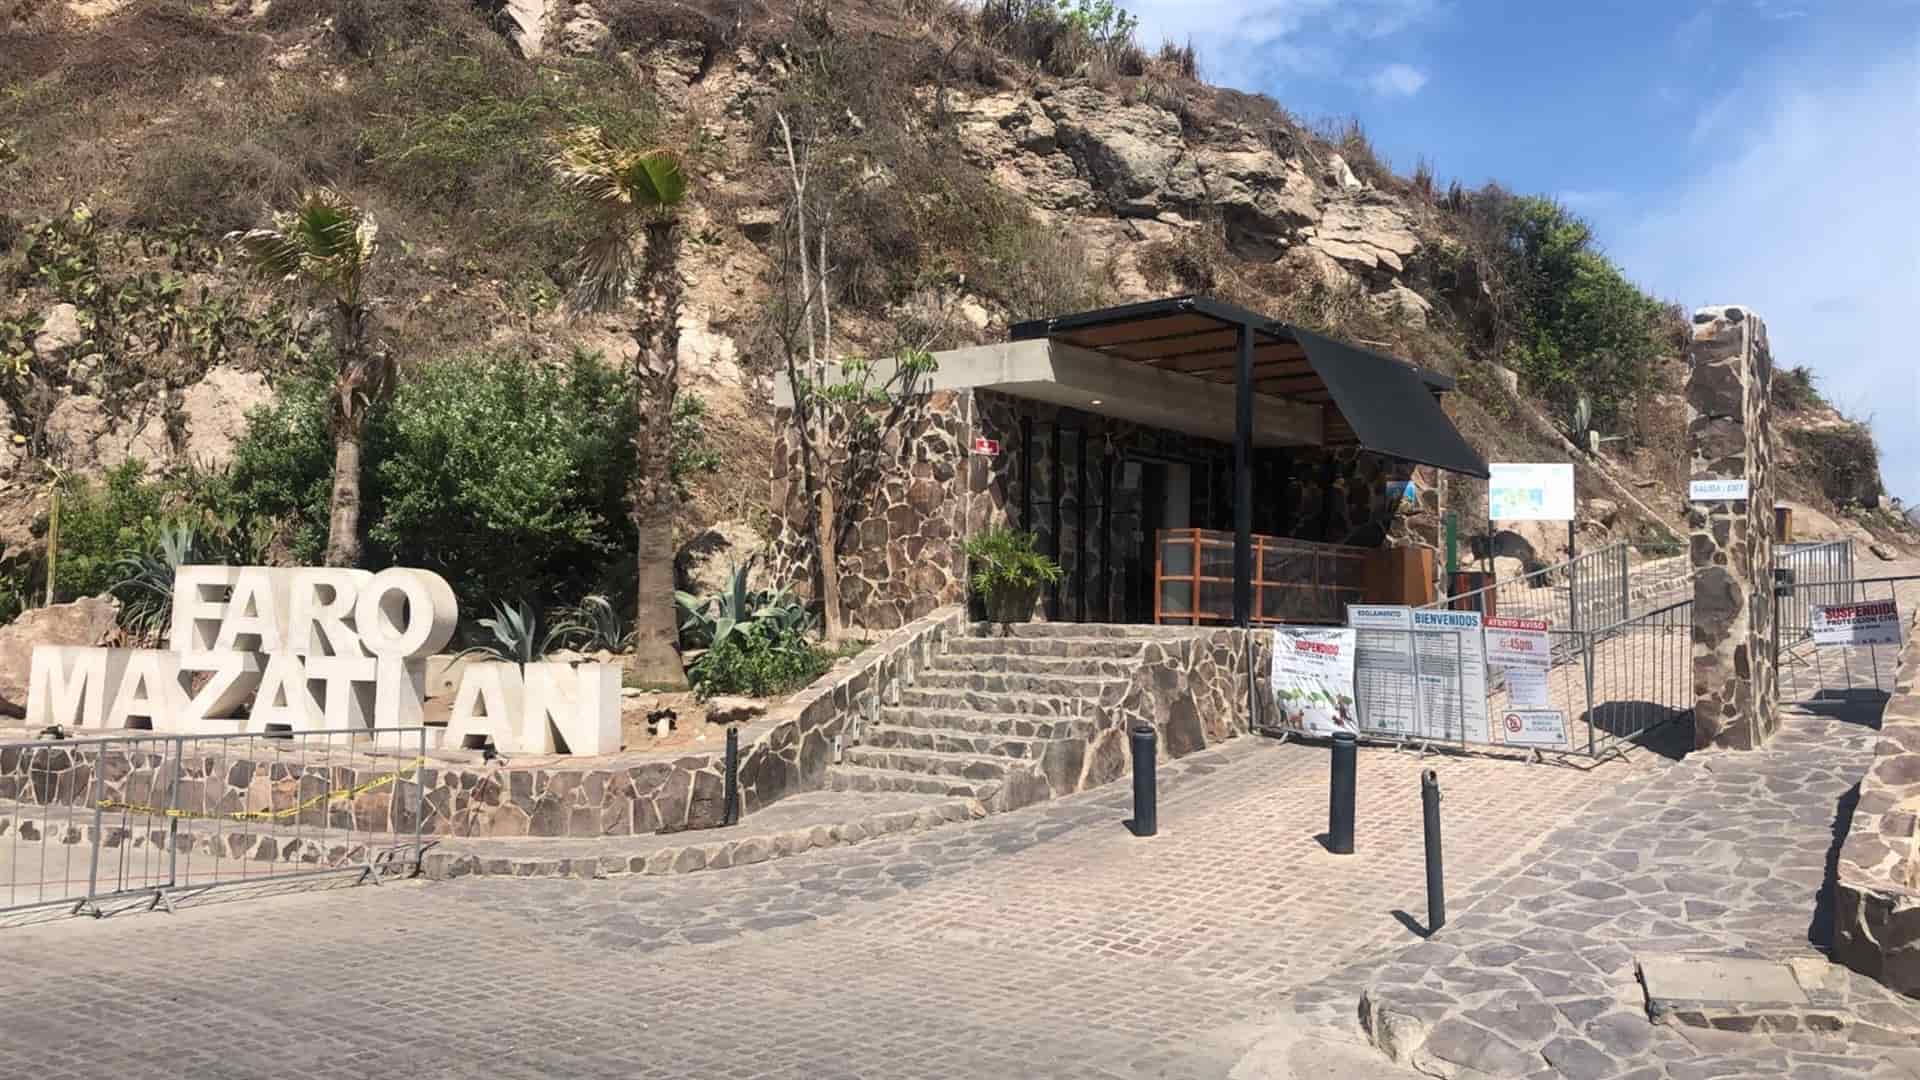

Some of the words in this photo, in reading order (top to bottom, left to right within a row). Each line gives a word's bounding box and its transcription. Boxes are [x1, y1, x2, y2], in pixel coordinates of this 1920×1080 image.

[171, 564, 458, 658] FARO
[1414, 612, 1479, 626] BIENVENIDOS
[1520, 621, 1544, 629] AVISO
[25, 647, 623, 754] MAZATLAN
